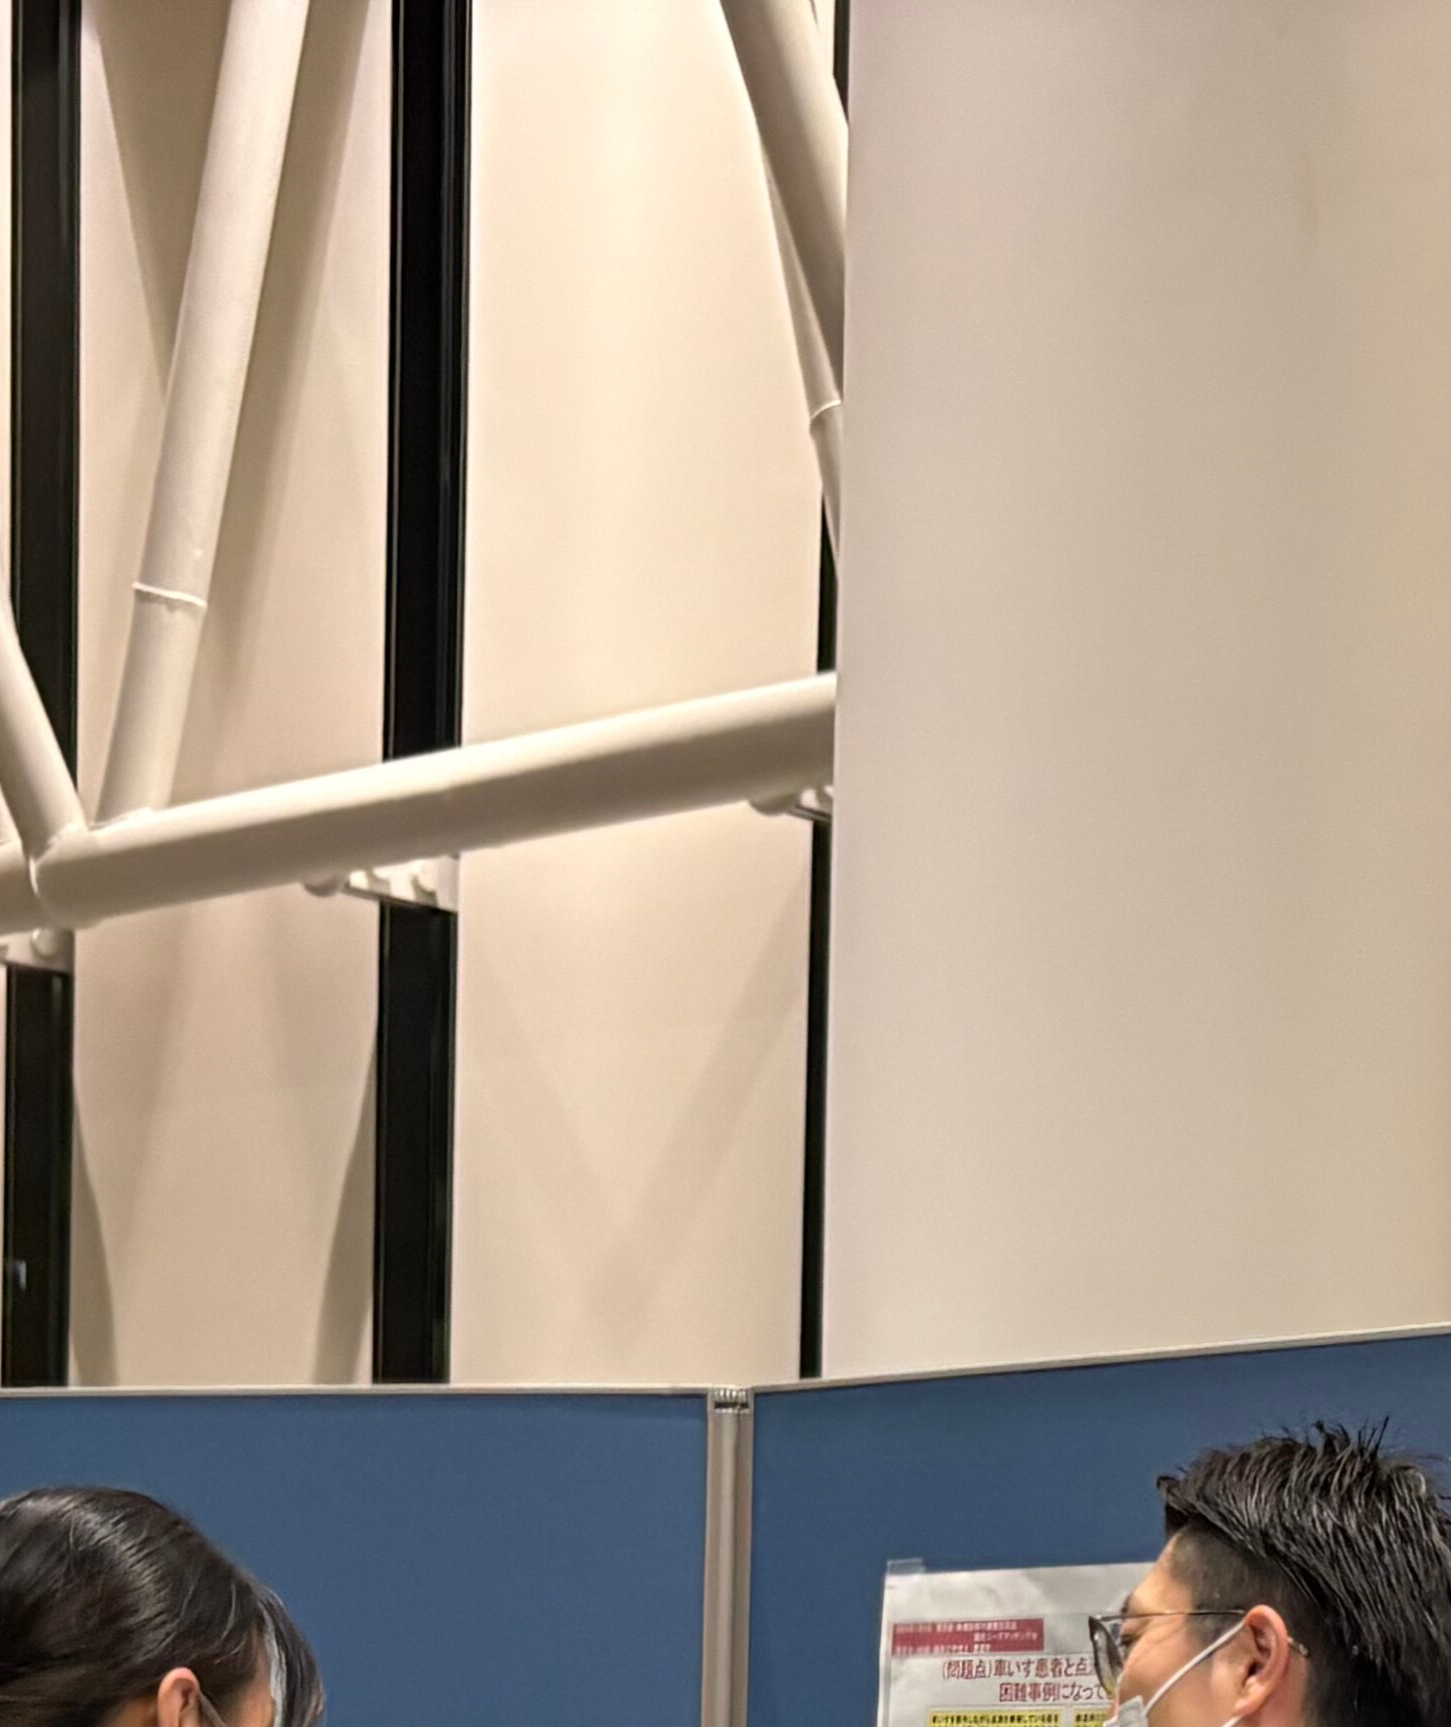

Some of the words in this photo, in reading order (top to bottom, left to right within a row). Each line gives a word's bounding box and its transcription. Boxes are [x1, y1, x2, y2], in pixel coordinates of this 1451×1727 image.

[942, 1655, 1095, 1680] (問題点)車いす患者と点
